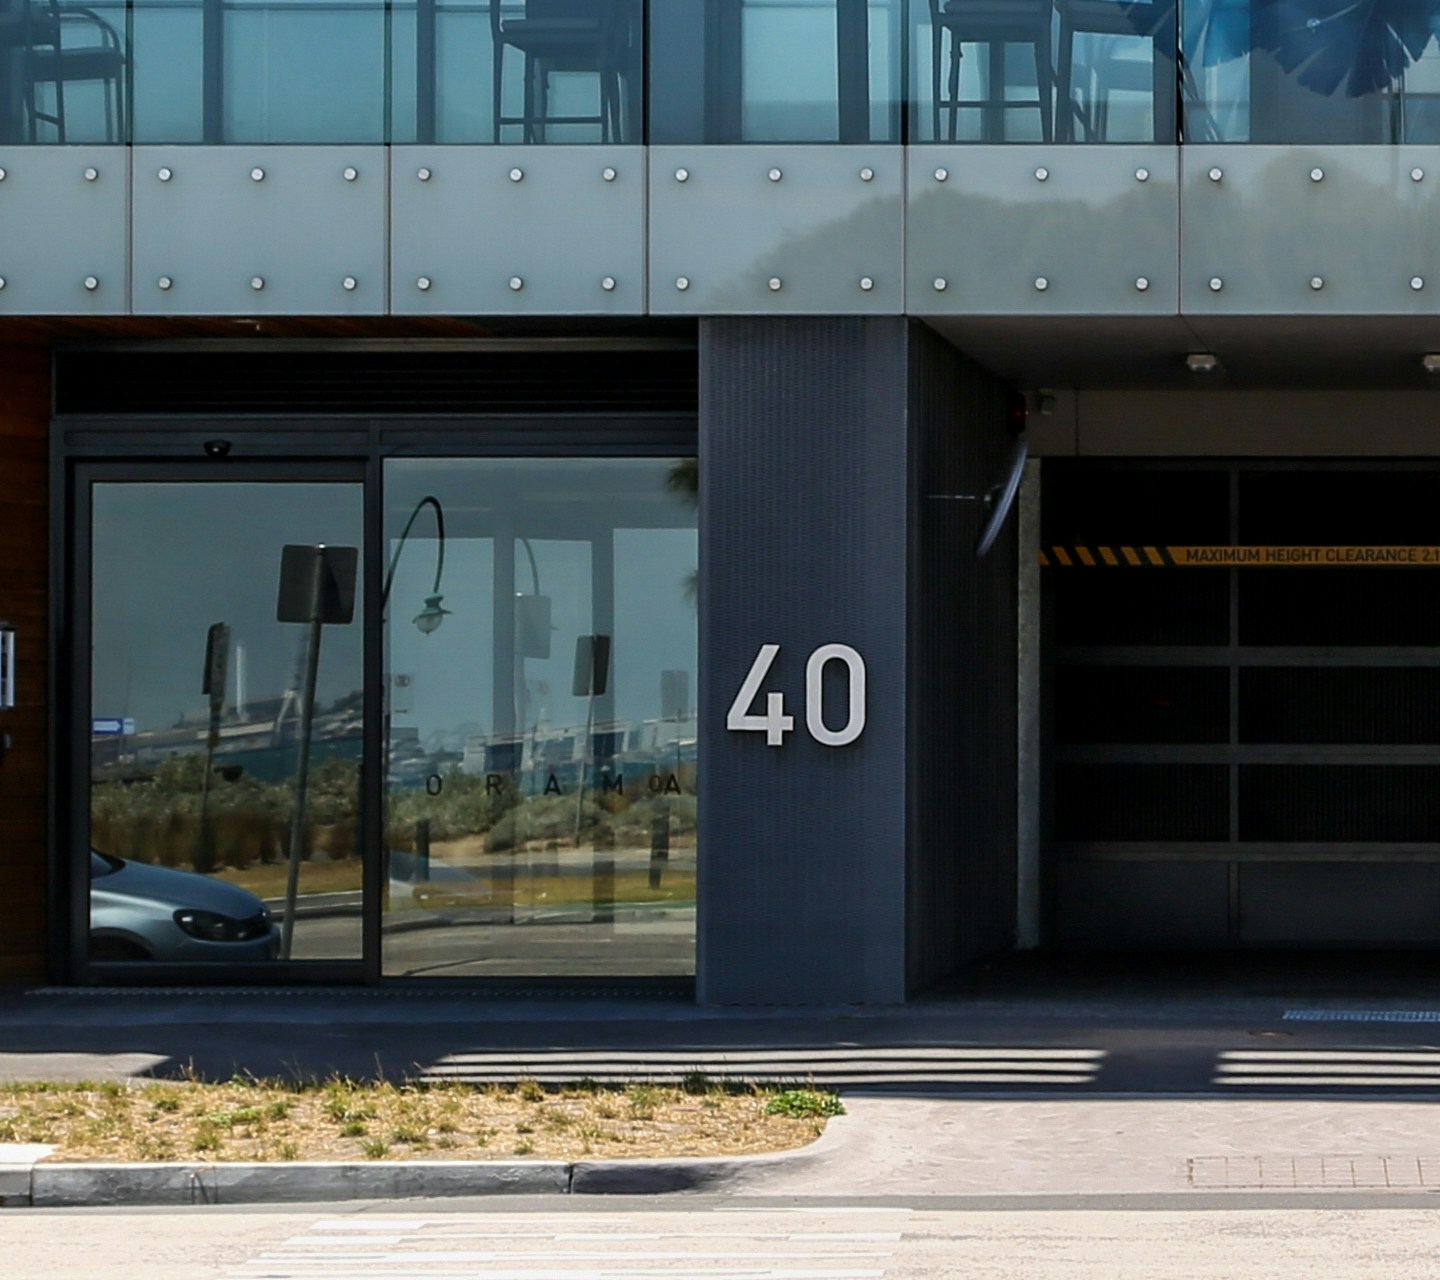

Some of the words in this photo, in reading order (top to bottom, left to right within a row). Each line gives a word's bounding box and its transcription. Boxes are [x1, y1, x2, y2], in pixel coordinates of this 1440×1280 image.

[1186, 548, 1260, 563] MAXIMUM
[1265, 548, 1321, 563] HEIGHT
[1325, 548, 1417, 563] CLEARANCE
[726, 643, 866, 746] 40
